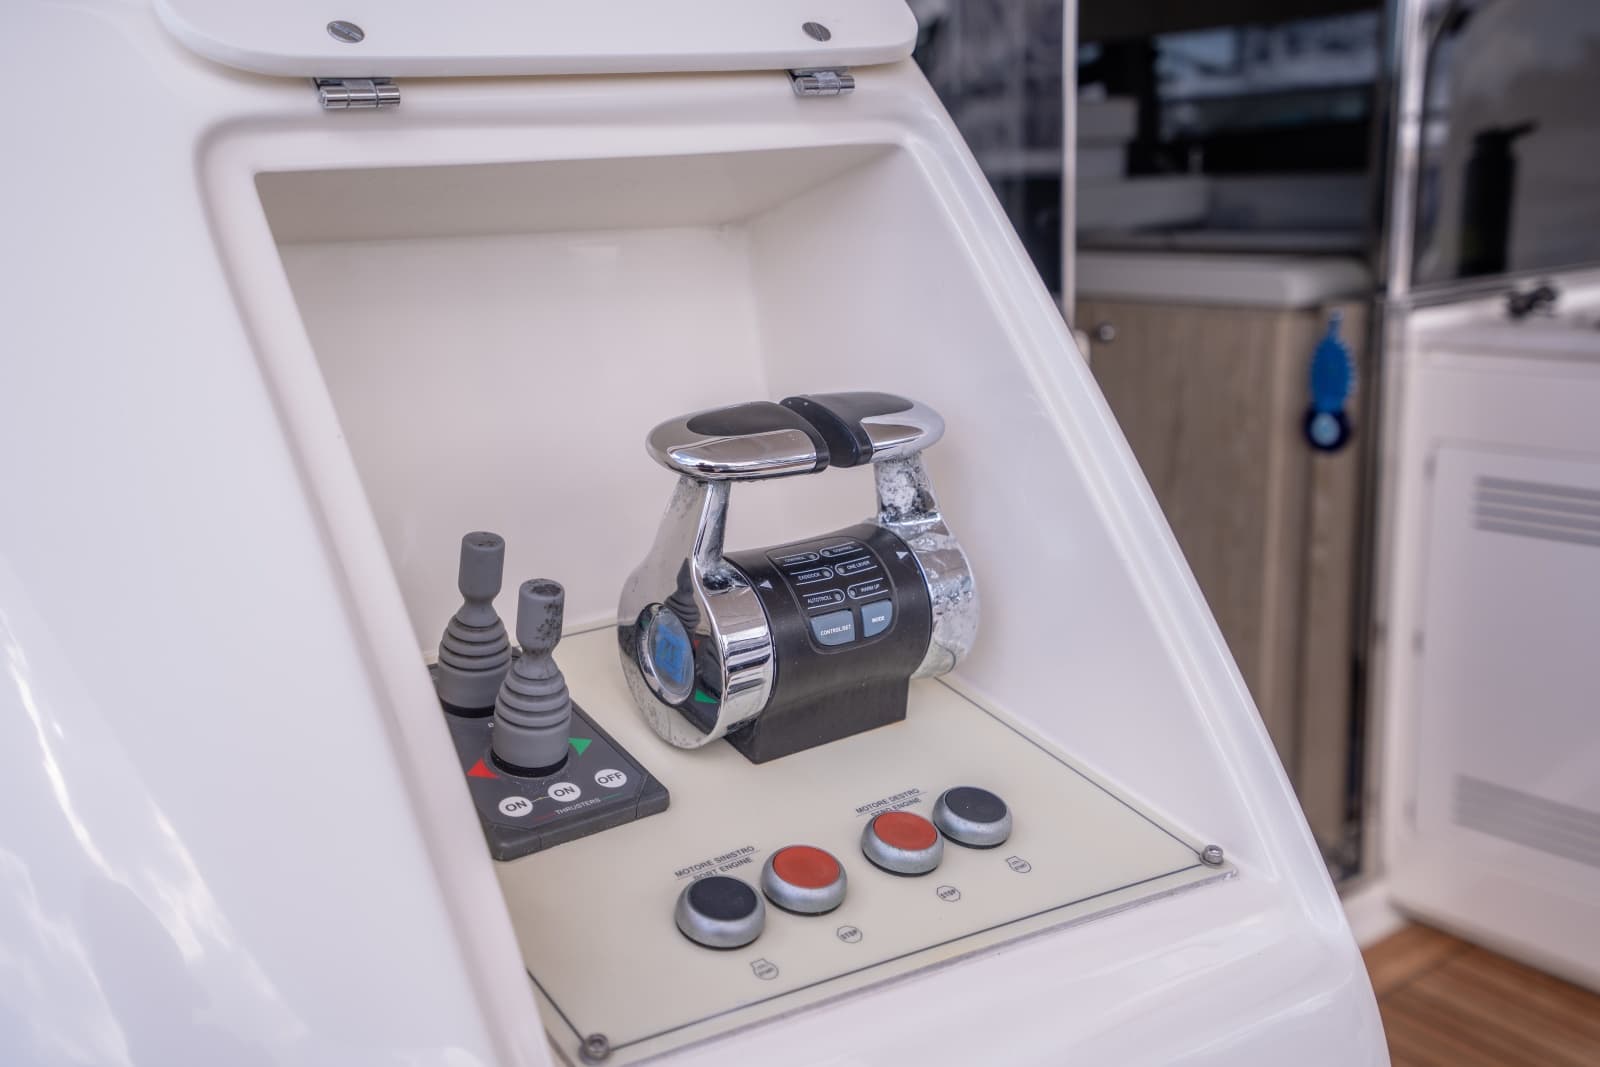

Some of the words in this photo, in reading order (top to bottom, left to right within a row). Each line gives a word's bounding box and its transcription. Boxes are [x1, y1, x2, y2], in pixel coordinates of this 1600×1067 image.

[597, 772, 623, 785] OFF
[554, 786, 576, 797] ON
[504, 800, 528, 812] ON
[555, 798, 601, 815] THRUSTERS
[855, 798, 889, 813] MOTORE
[888, 788, 920, 802] DESTRO
[892, 797, 922, 810] ENGINE
[674, 860, 714, 877] MOTORE
[713, 845, 755, 863] SINISTRO
[718, 857, 753, 873] ENGINE
[840, 929, 857, 940] STOP
